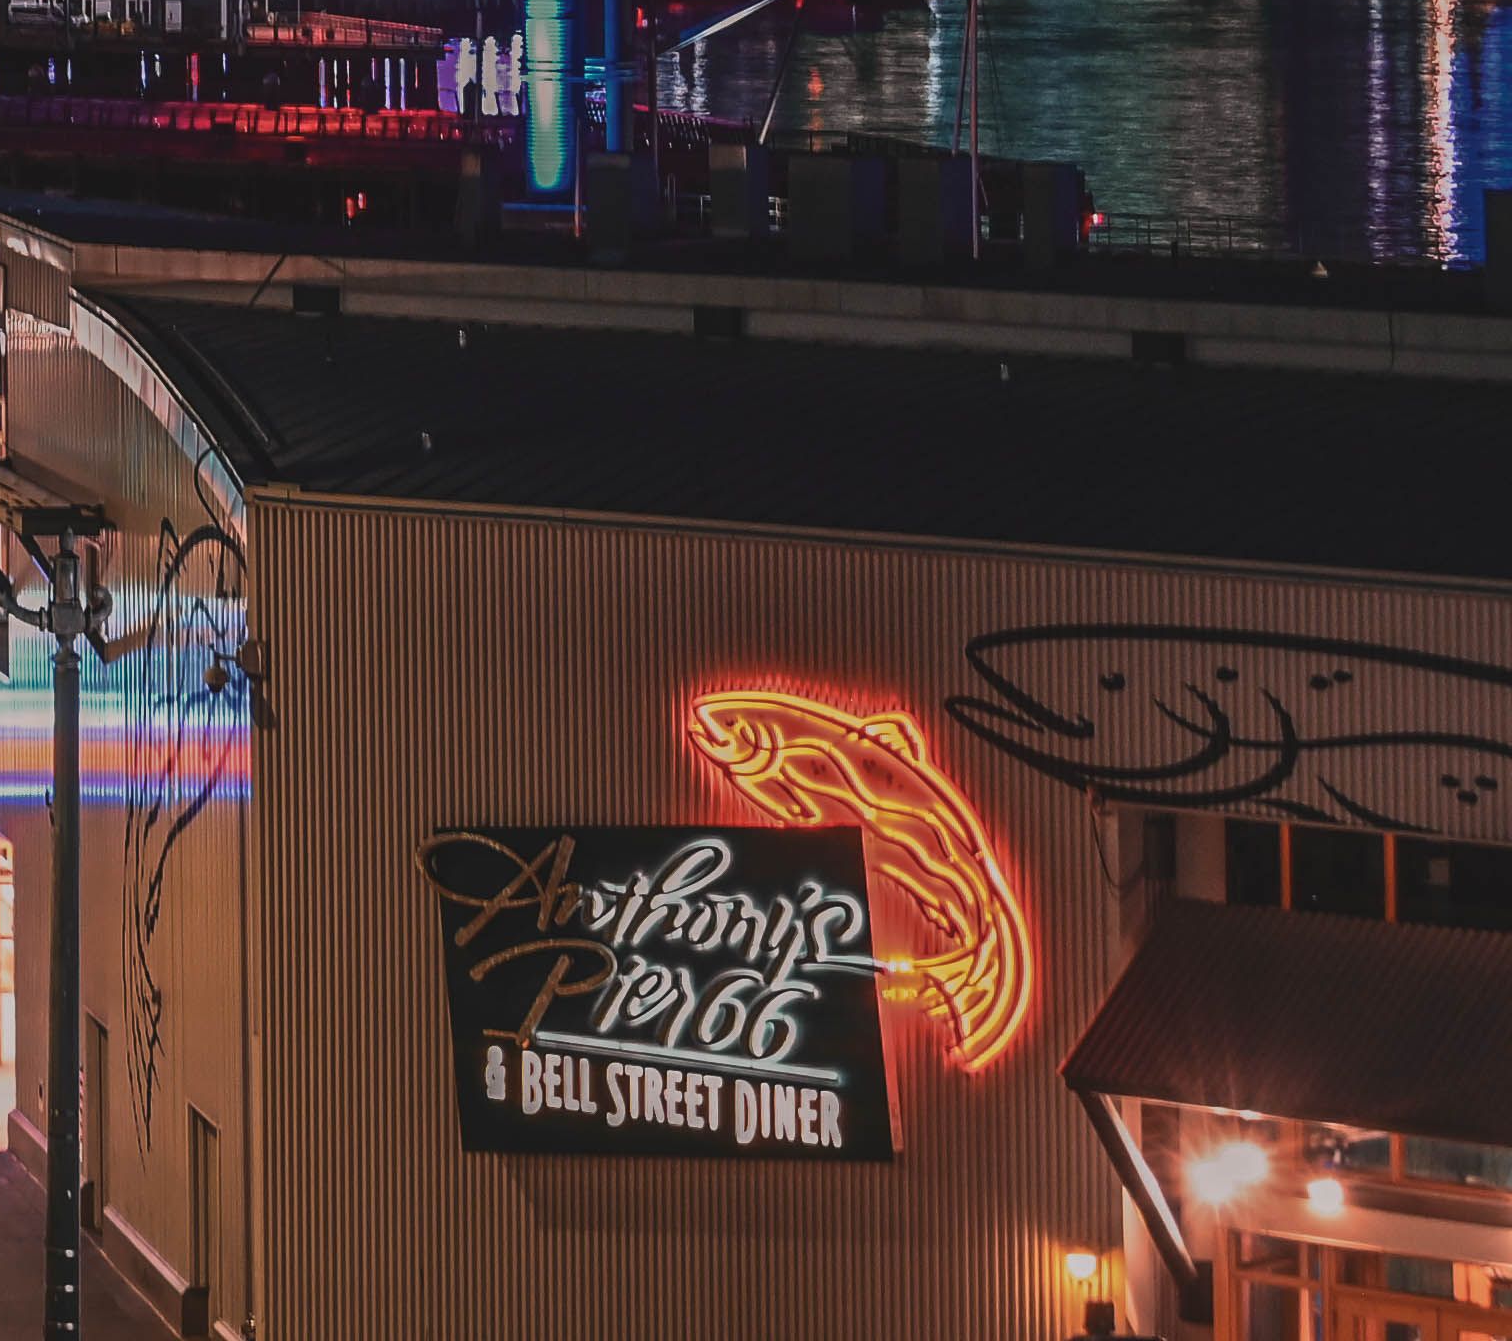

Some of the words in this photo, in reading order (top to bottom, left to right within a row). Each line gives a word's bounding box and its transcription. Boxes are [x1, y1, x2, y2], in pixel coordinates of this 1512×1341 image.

[415, 831, 884, 990] Anthony's
[469, 937, 695, 1051] Pier
[695, 969, 822, 1064] 66
[484, 1044, 507, 1101] &
[520, 1048, 598, 1116] BELL
[604, 1060, 724, 1128] STREET
[734, 1078, 844, 1149] DINER
